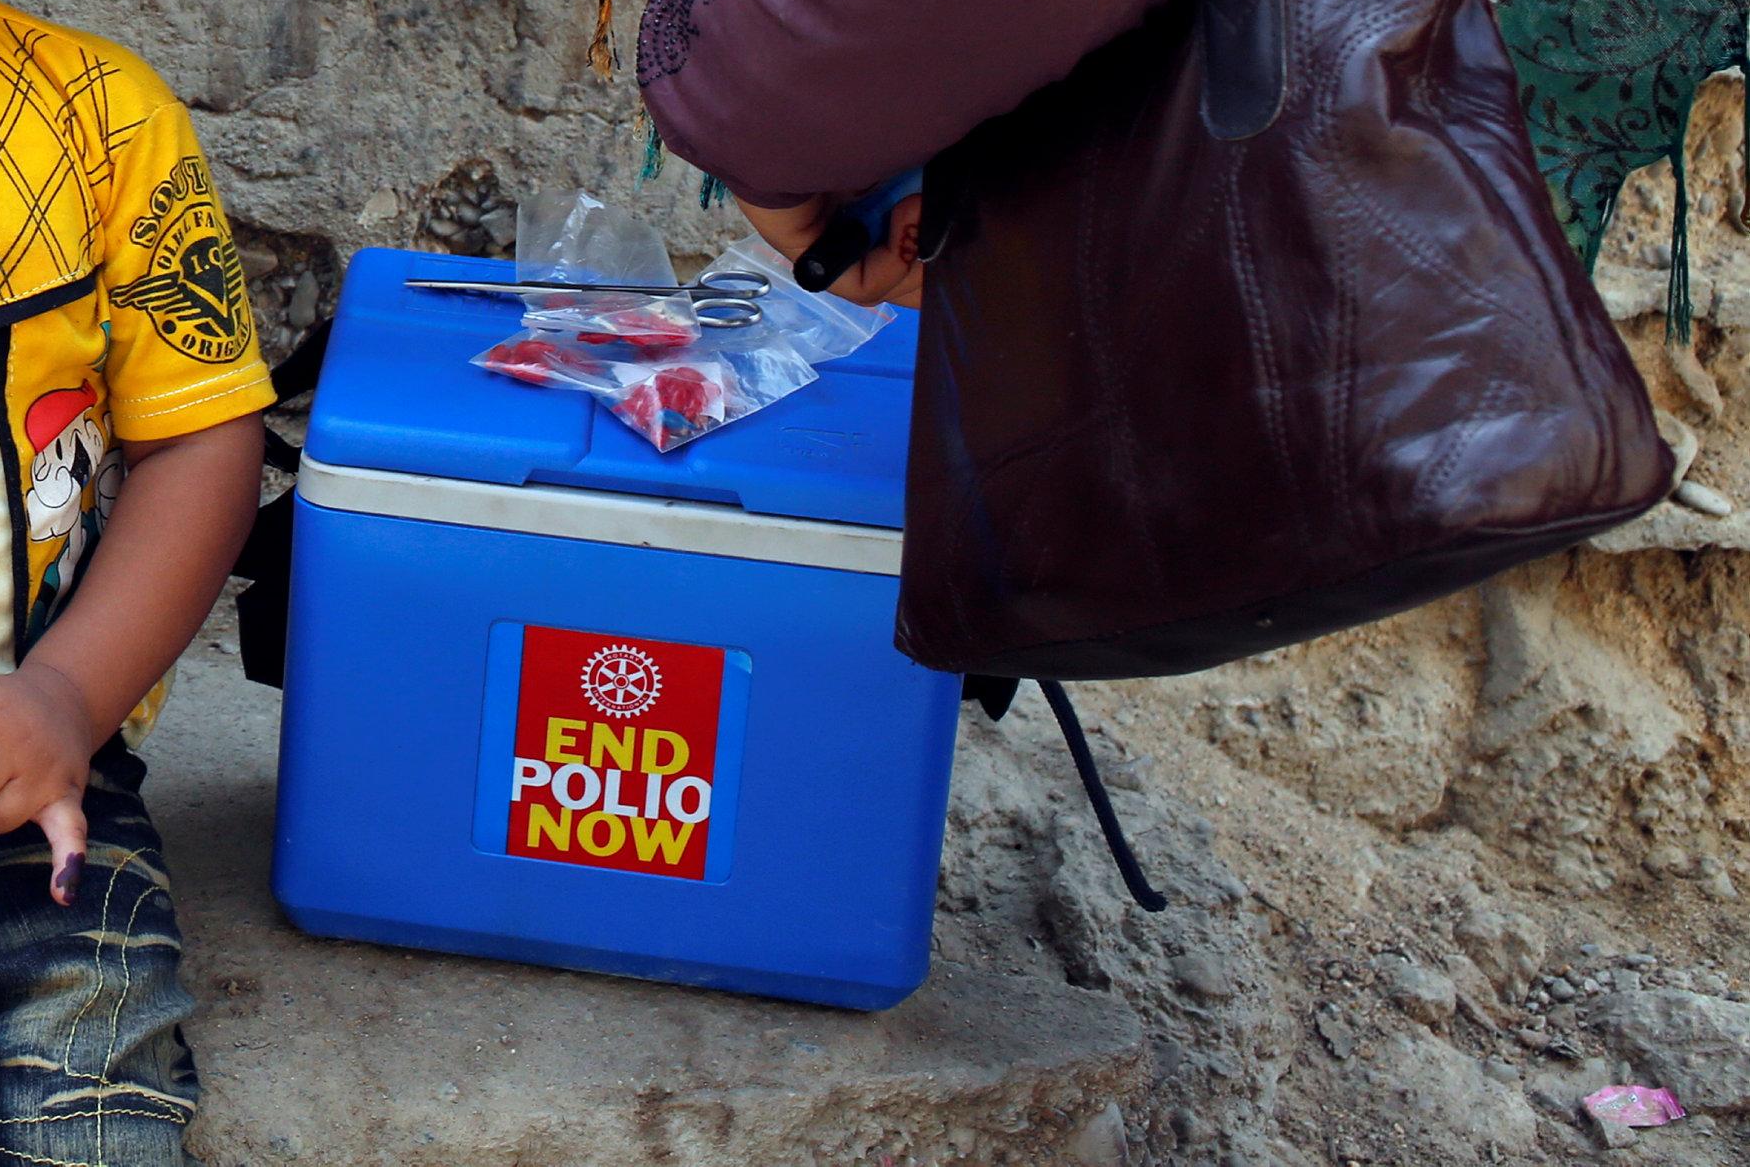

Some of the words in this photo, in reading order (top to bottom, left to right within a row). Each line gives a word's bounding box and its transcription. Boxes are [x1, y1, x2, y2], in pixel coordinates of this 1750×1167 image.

[606, 653, 640, 662] ROTARY
[593, 689, 649, 710] INTERNATIONAL
[544, 716, 690, 775] END
[511, 756, 713, 823] POLIO
[526, 803, 696, 865] NOW
